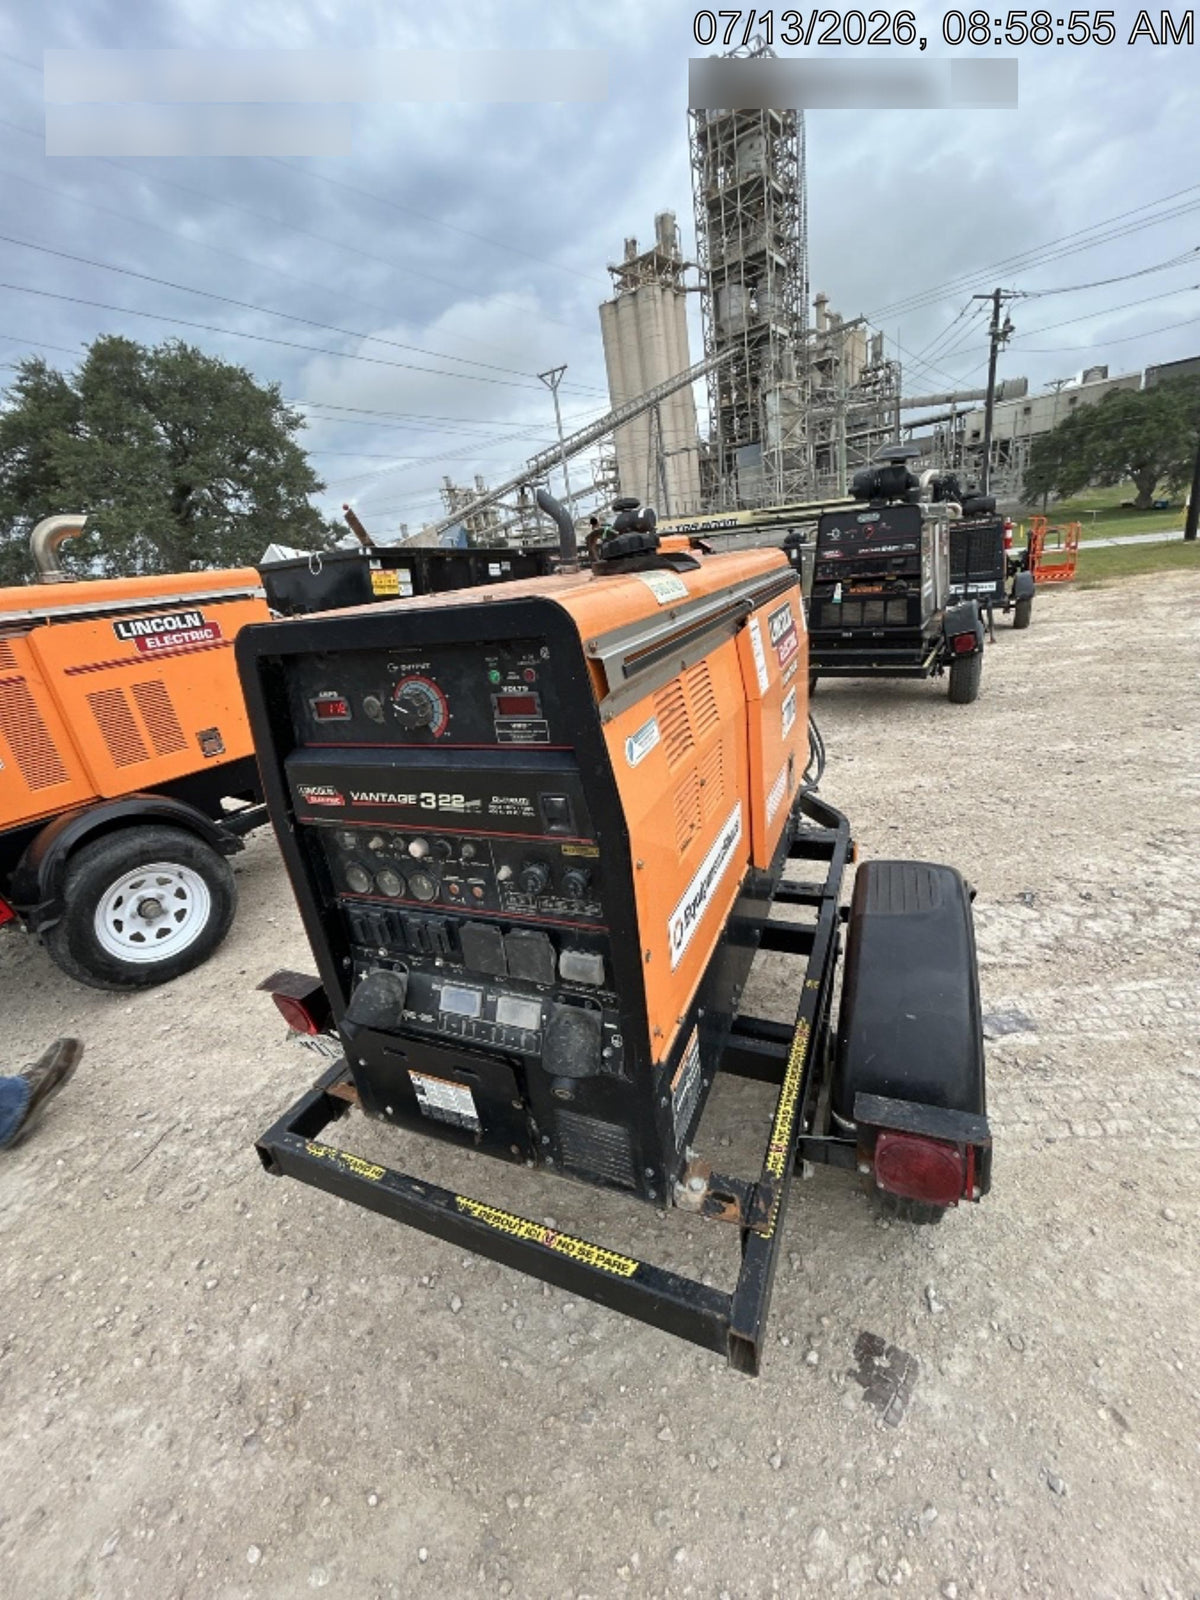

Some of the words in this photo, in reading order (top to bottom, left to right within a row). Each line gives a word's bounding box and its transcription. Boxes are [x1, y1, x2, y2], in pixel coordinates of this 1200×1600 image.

[118, 613, 201, 638] LINCOLN
[145, 629, 214, 648] ELECTRIC
[349, 790, 418, 805] VANTAGE
[420, 792, 465, 809] 322
[477, 1207, 524, 1233] DEBOUT
[524, 1224, 541, 1239] ICI
[555, 1237, 576, 1253] NO
[576, 1245, 595, 1260] SE
[594, 1253, 630, 1273] PARE
